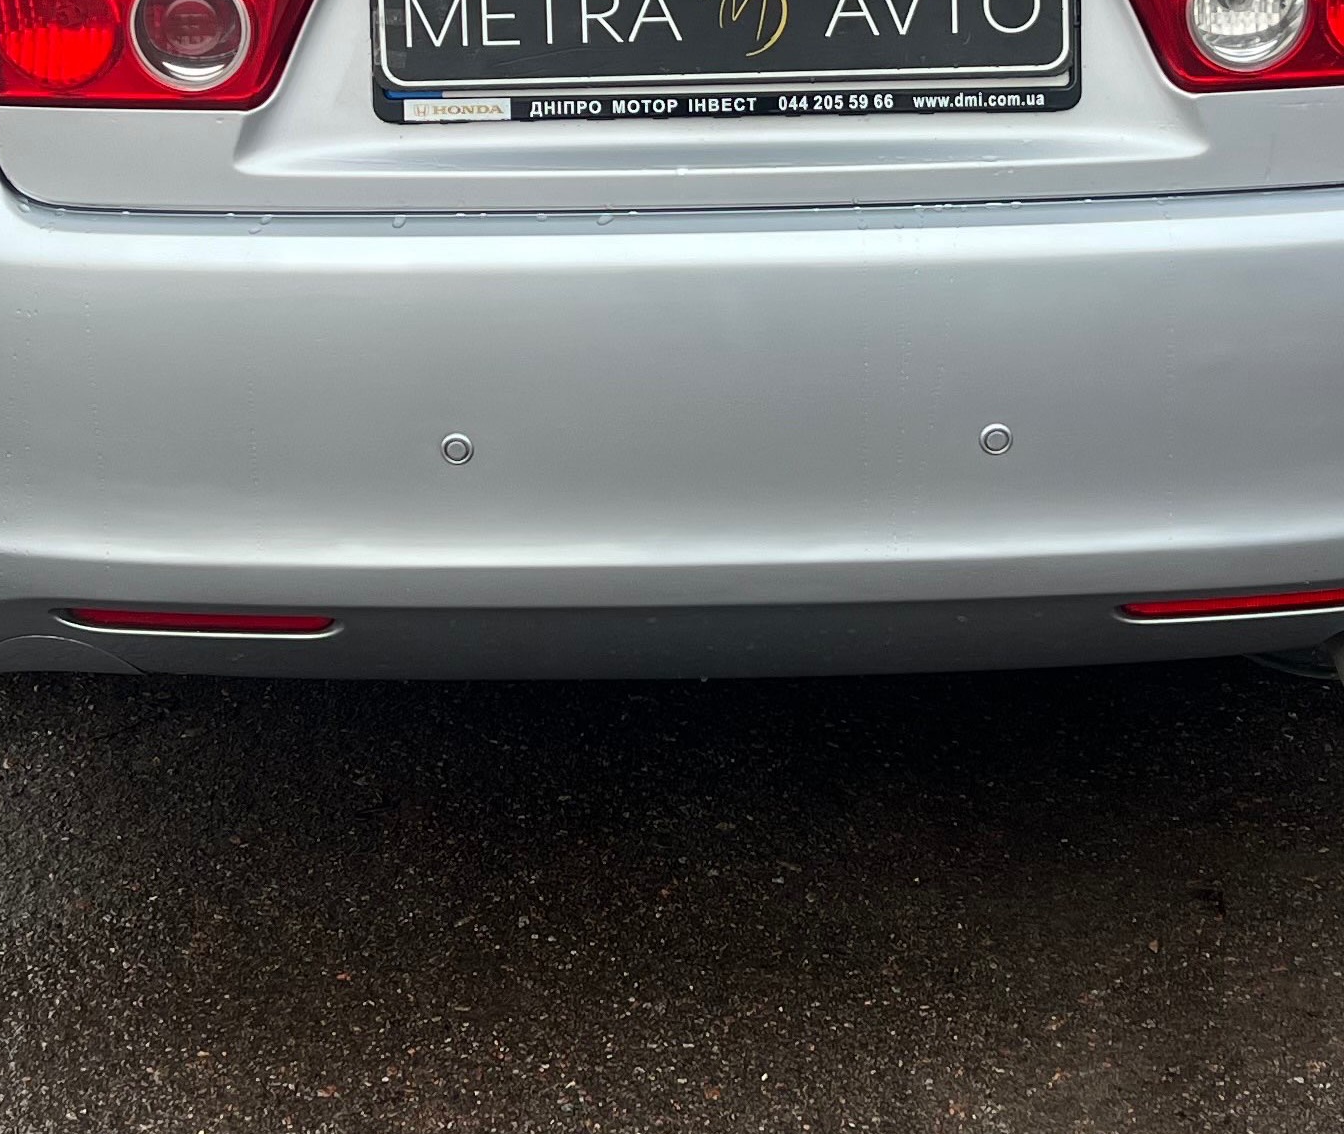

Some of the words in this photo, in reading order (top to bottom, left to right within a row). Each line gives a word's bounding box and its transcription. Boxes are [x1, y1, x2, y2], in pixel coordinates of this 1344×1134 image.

[431, 104, 505, 116] HONDA
[529, 100, 603, 119] ДНІПРО
[611, 98, 680, 115] МОТОР
[687, 96, 758, 114] ІНВЕСТ
[777, 95, 808, 111] 044
[812, 94, 845, 110] 205
[848, 94, 869, 110] 59
[873, 93, 895, 109] 66
[912, 91, 1046, 109] www.dmi.com.ua
